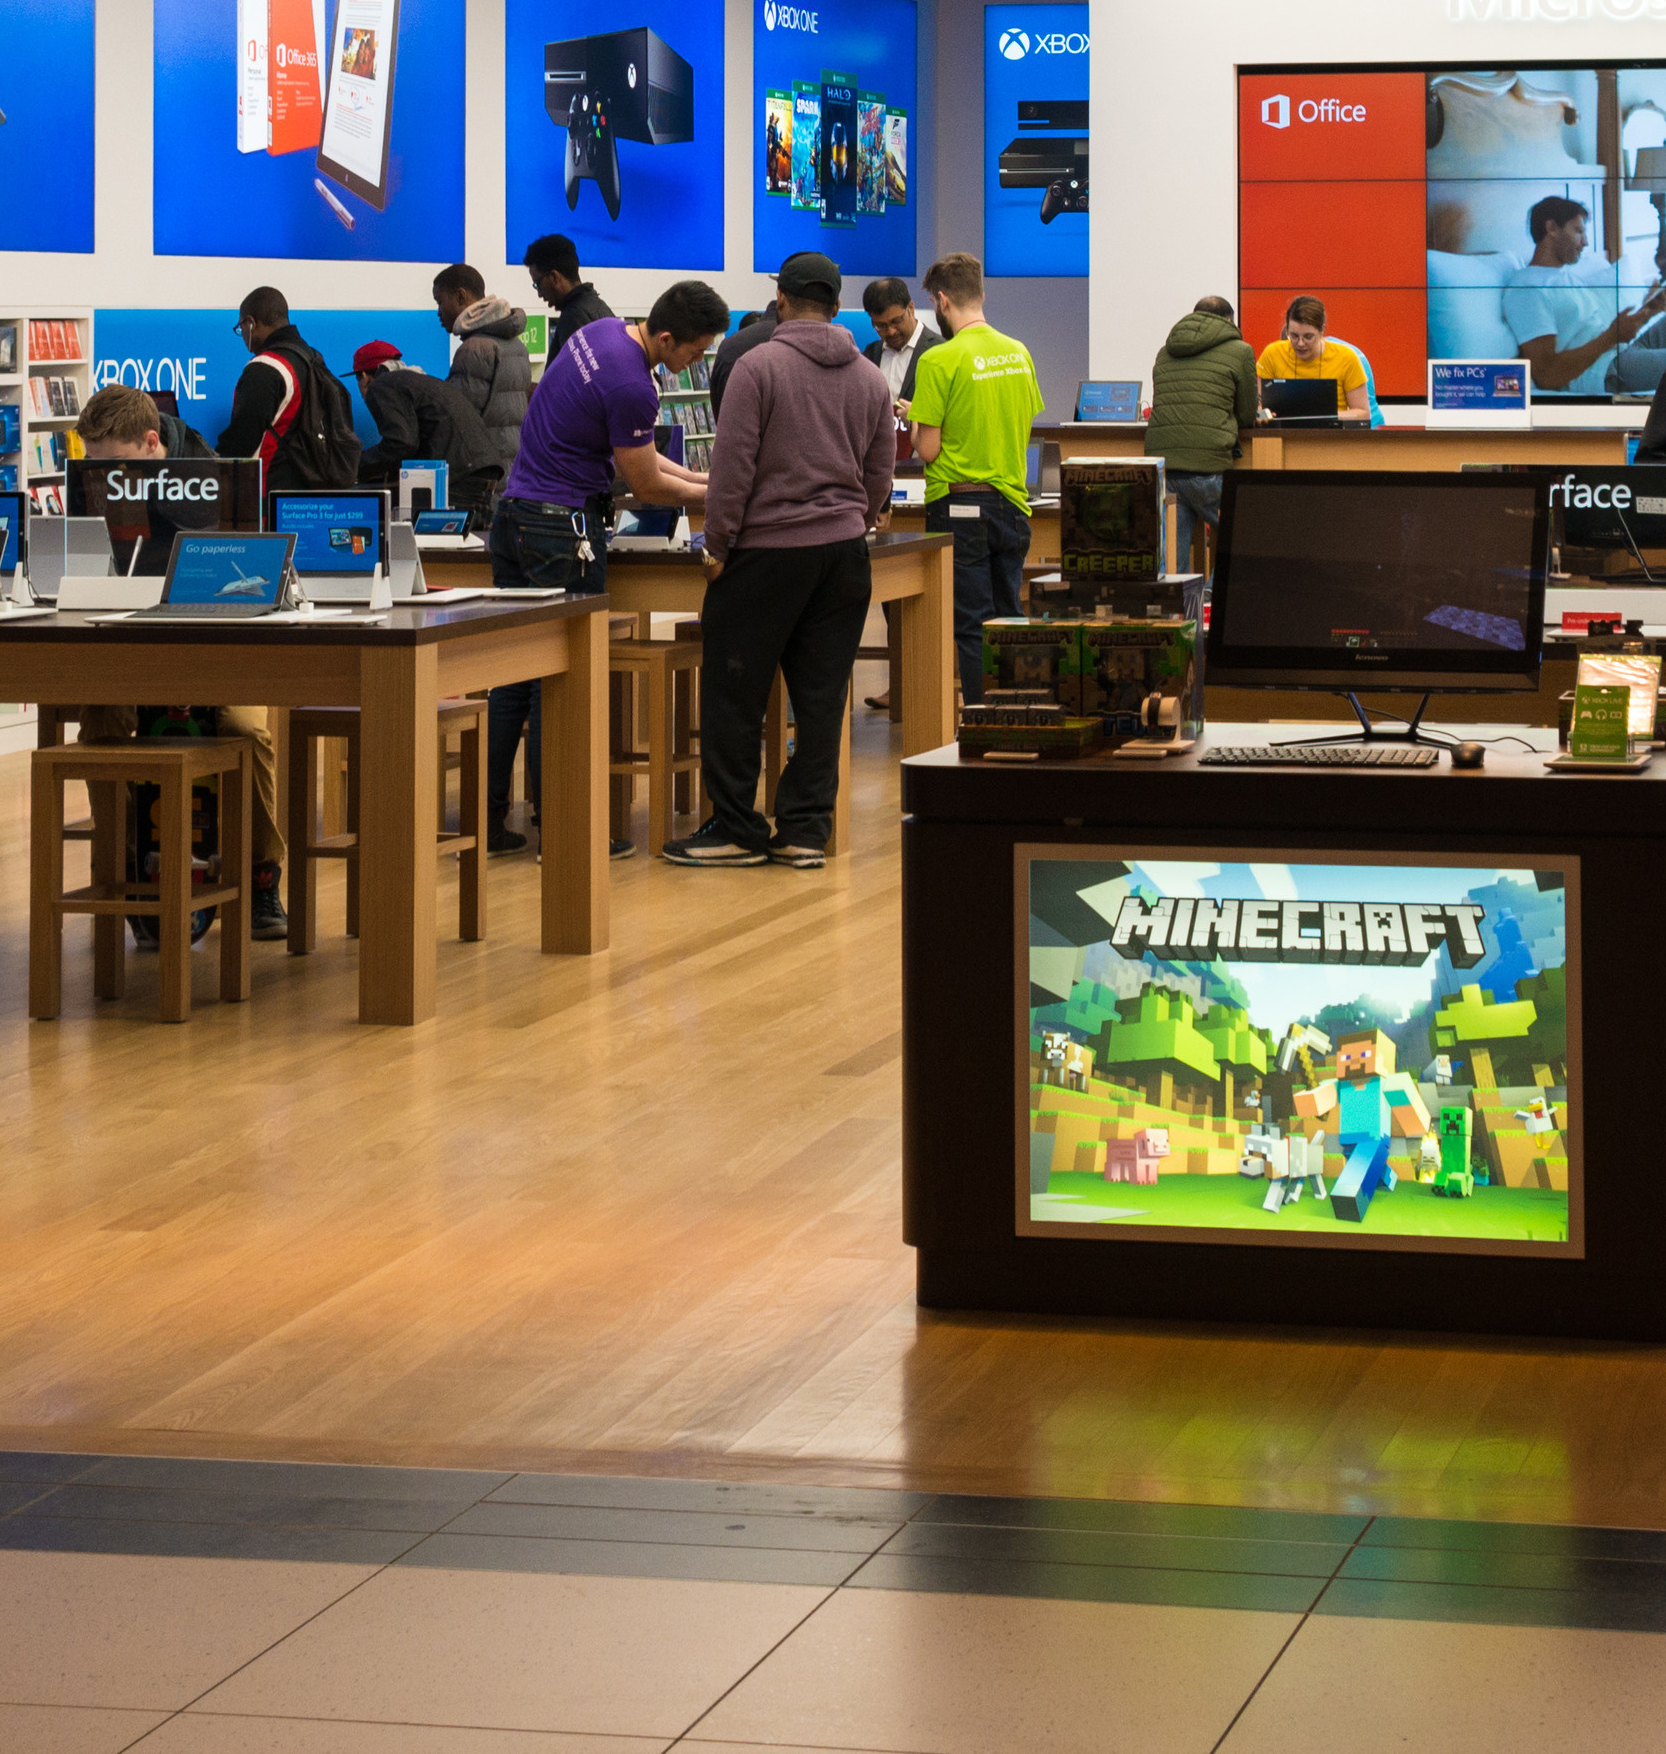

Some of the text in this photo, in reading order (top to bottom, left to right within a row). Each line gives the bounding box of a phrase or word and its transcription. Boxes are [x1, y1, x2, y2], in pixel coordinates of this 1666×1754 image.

[777, 4, 819, 33] XBOX ONE
[1034, 32, 1090, 55] XBOX
[287, 49, 317, 66] Office 365
[827, 86, 851, 101] HALO
[1298, 98, 1367, 123] Office
[530, 327, 537, 343] 12
[986, 354, 1010, 367] XBOX
[156, 357, 207, 401] ONE
[1005, 366, 1023, 375] Xbox
[1435, 367, 1452, 378] We
[1454, 366, 1465, 378] fix
[106, 468, 219, 501] Surface
[1064, 467, 1153, 486] MINECRAFT
[1549, 474, 1632, 509] rface
[282, 502, 334, 512] Accessorize your
[282, 511, 304, 520] Surface
[306, 512, 317, 520] Pro
[324, 511, 333, 520] for
[333, 511, 347, 521] just
[347, 511, 363, 520] $299
[186, 544, 246, 555] Go paperless
[1063, 554, 1154, 574] CREEPER
[989, 629, 1074, 646] MINECRAFT
[1110, 896, 1486, 970] MINECRAFT
